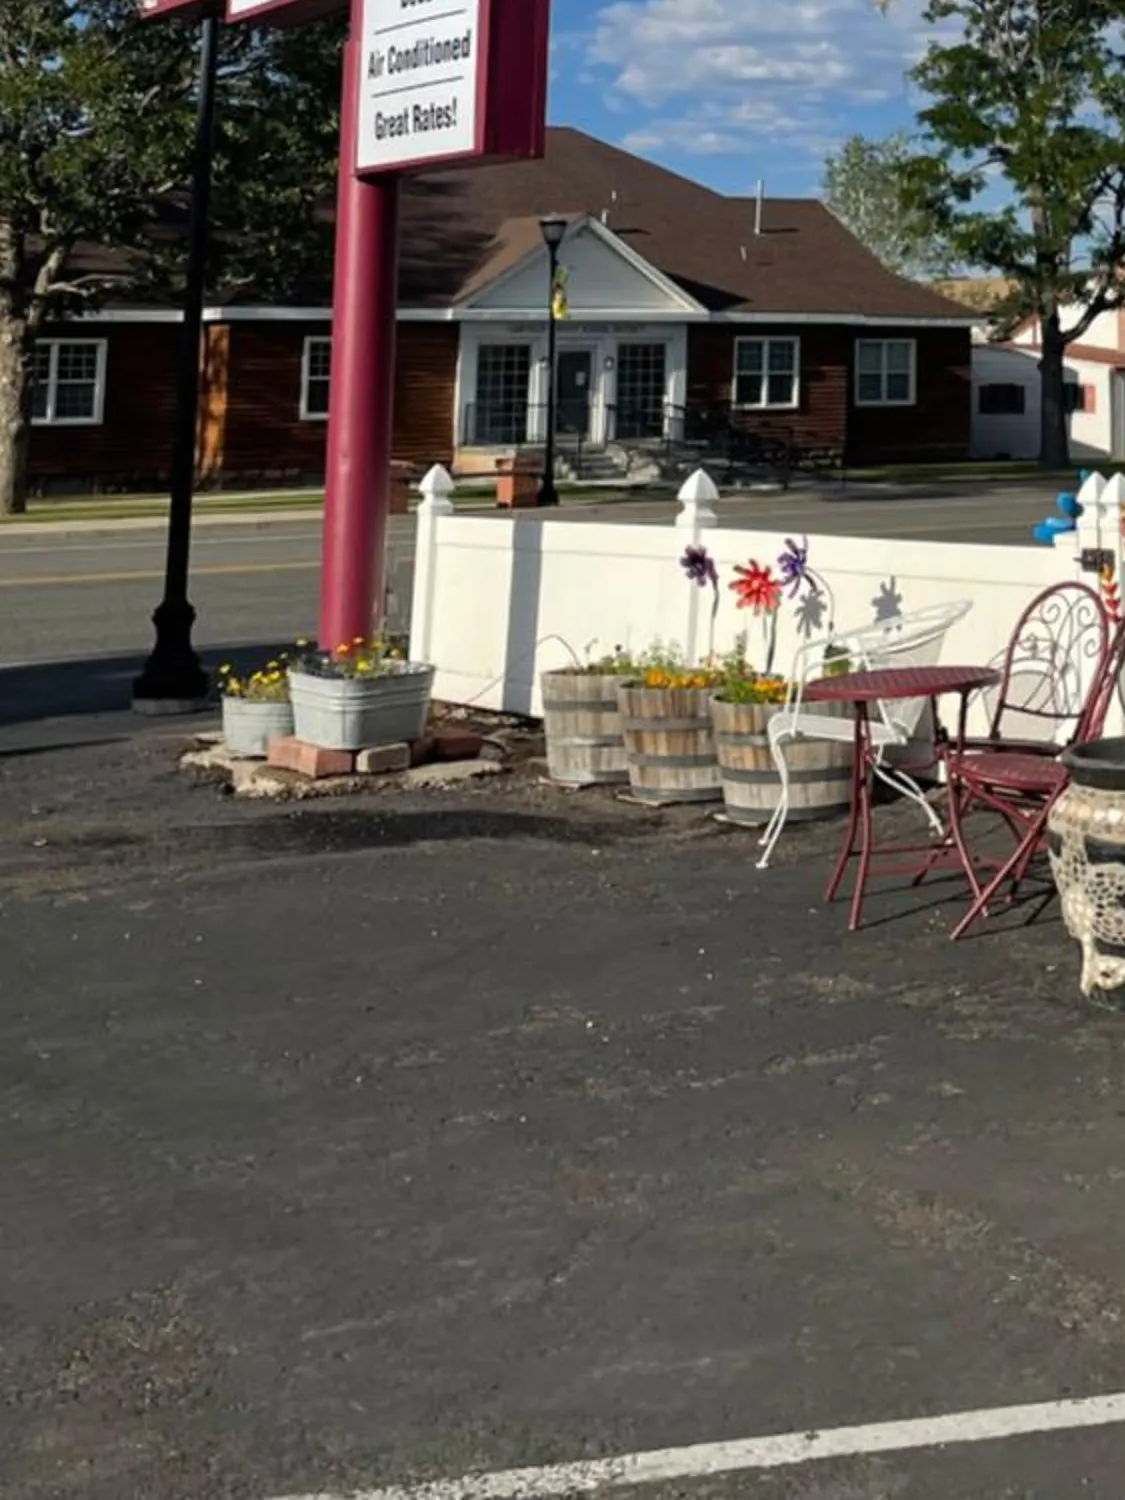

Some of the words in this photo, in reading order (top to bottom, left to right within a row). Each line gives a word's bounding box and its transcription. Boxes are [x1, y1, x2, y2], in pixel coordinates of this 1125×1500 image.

[368, 50, 385, 79] Air
[387, 28, 472, 75] Conditioned
[374, 107, 410, 141] Great
[412, 96, 458, 133] Rates!
